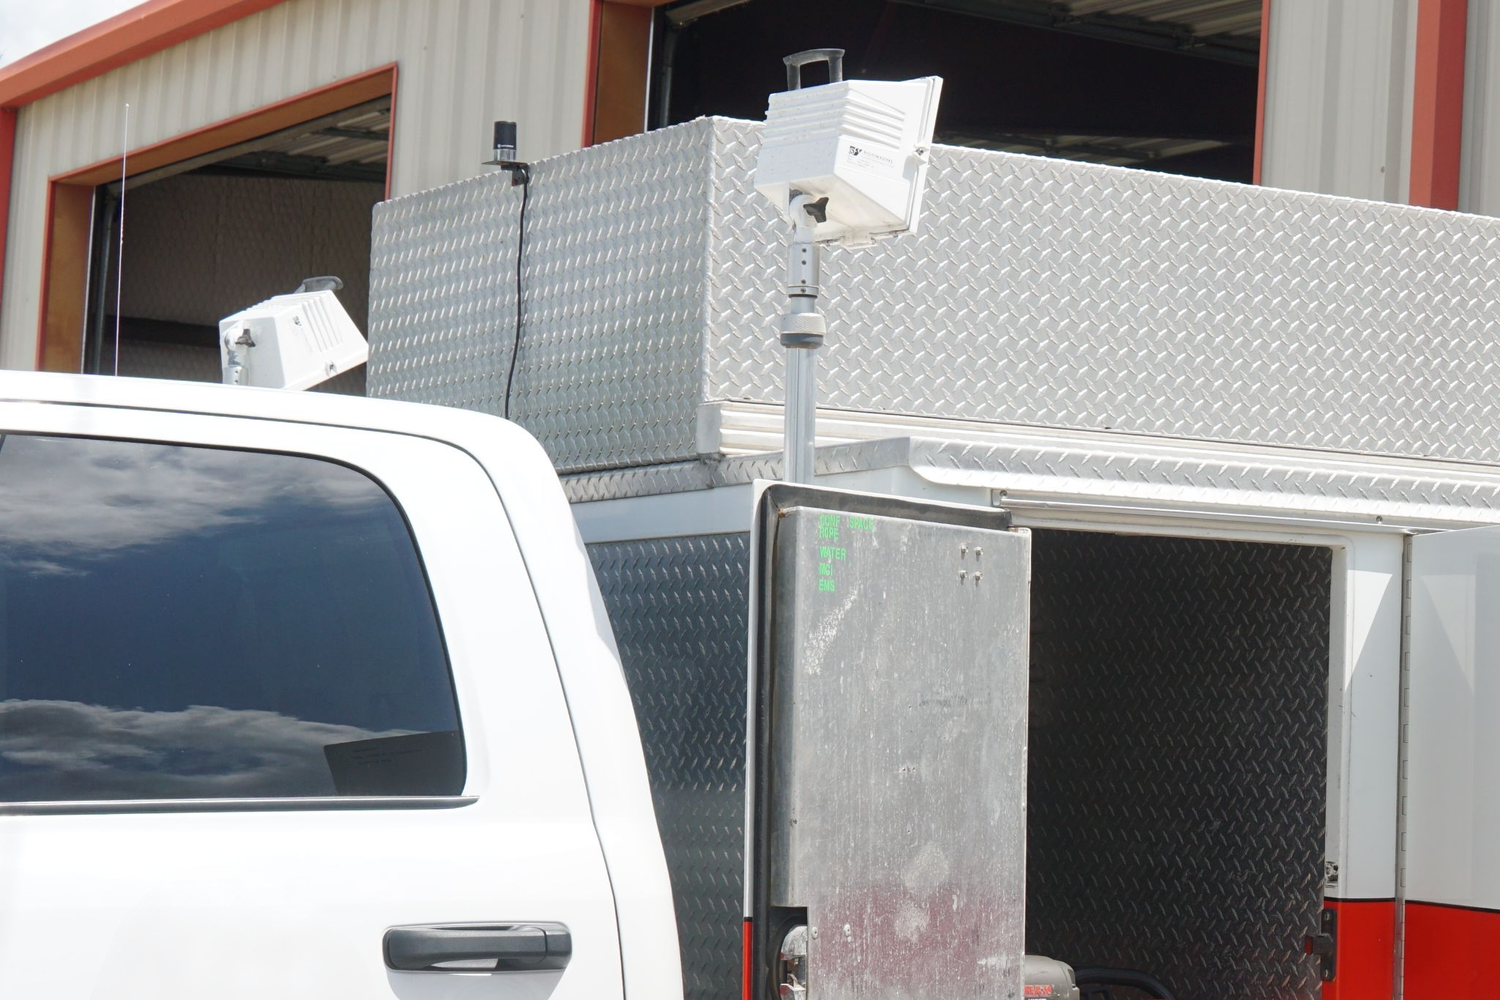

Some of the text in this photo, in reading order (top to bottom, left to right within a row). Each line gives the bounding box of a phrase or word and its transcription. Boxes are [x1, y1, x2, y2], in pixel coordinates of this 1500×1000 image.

[819, 514, 875, 532] CONF SPACE
[819, 527, 839, 540] ROPE
[819, 545, 846, 561] WATER
[818, 579, 835, 593] EMS
